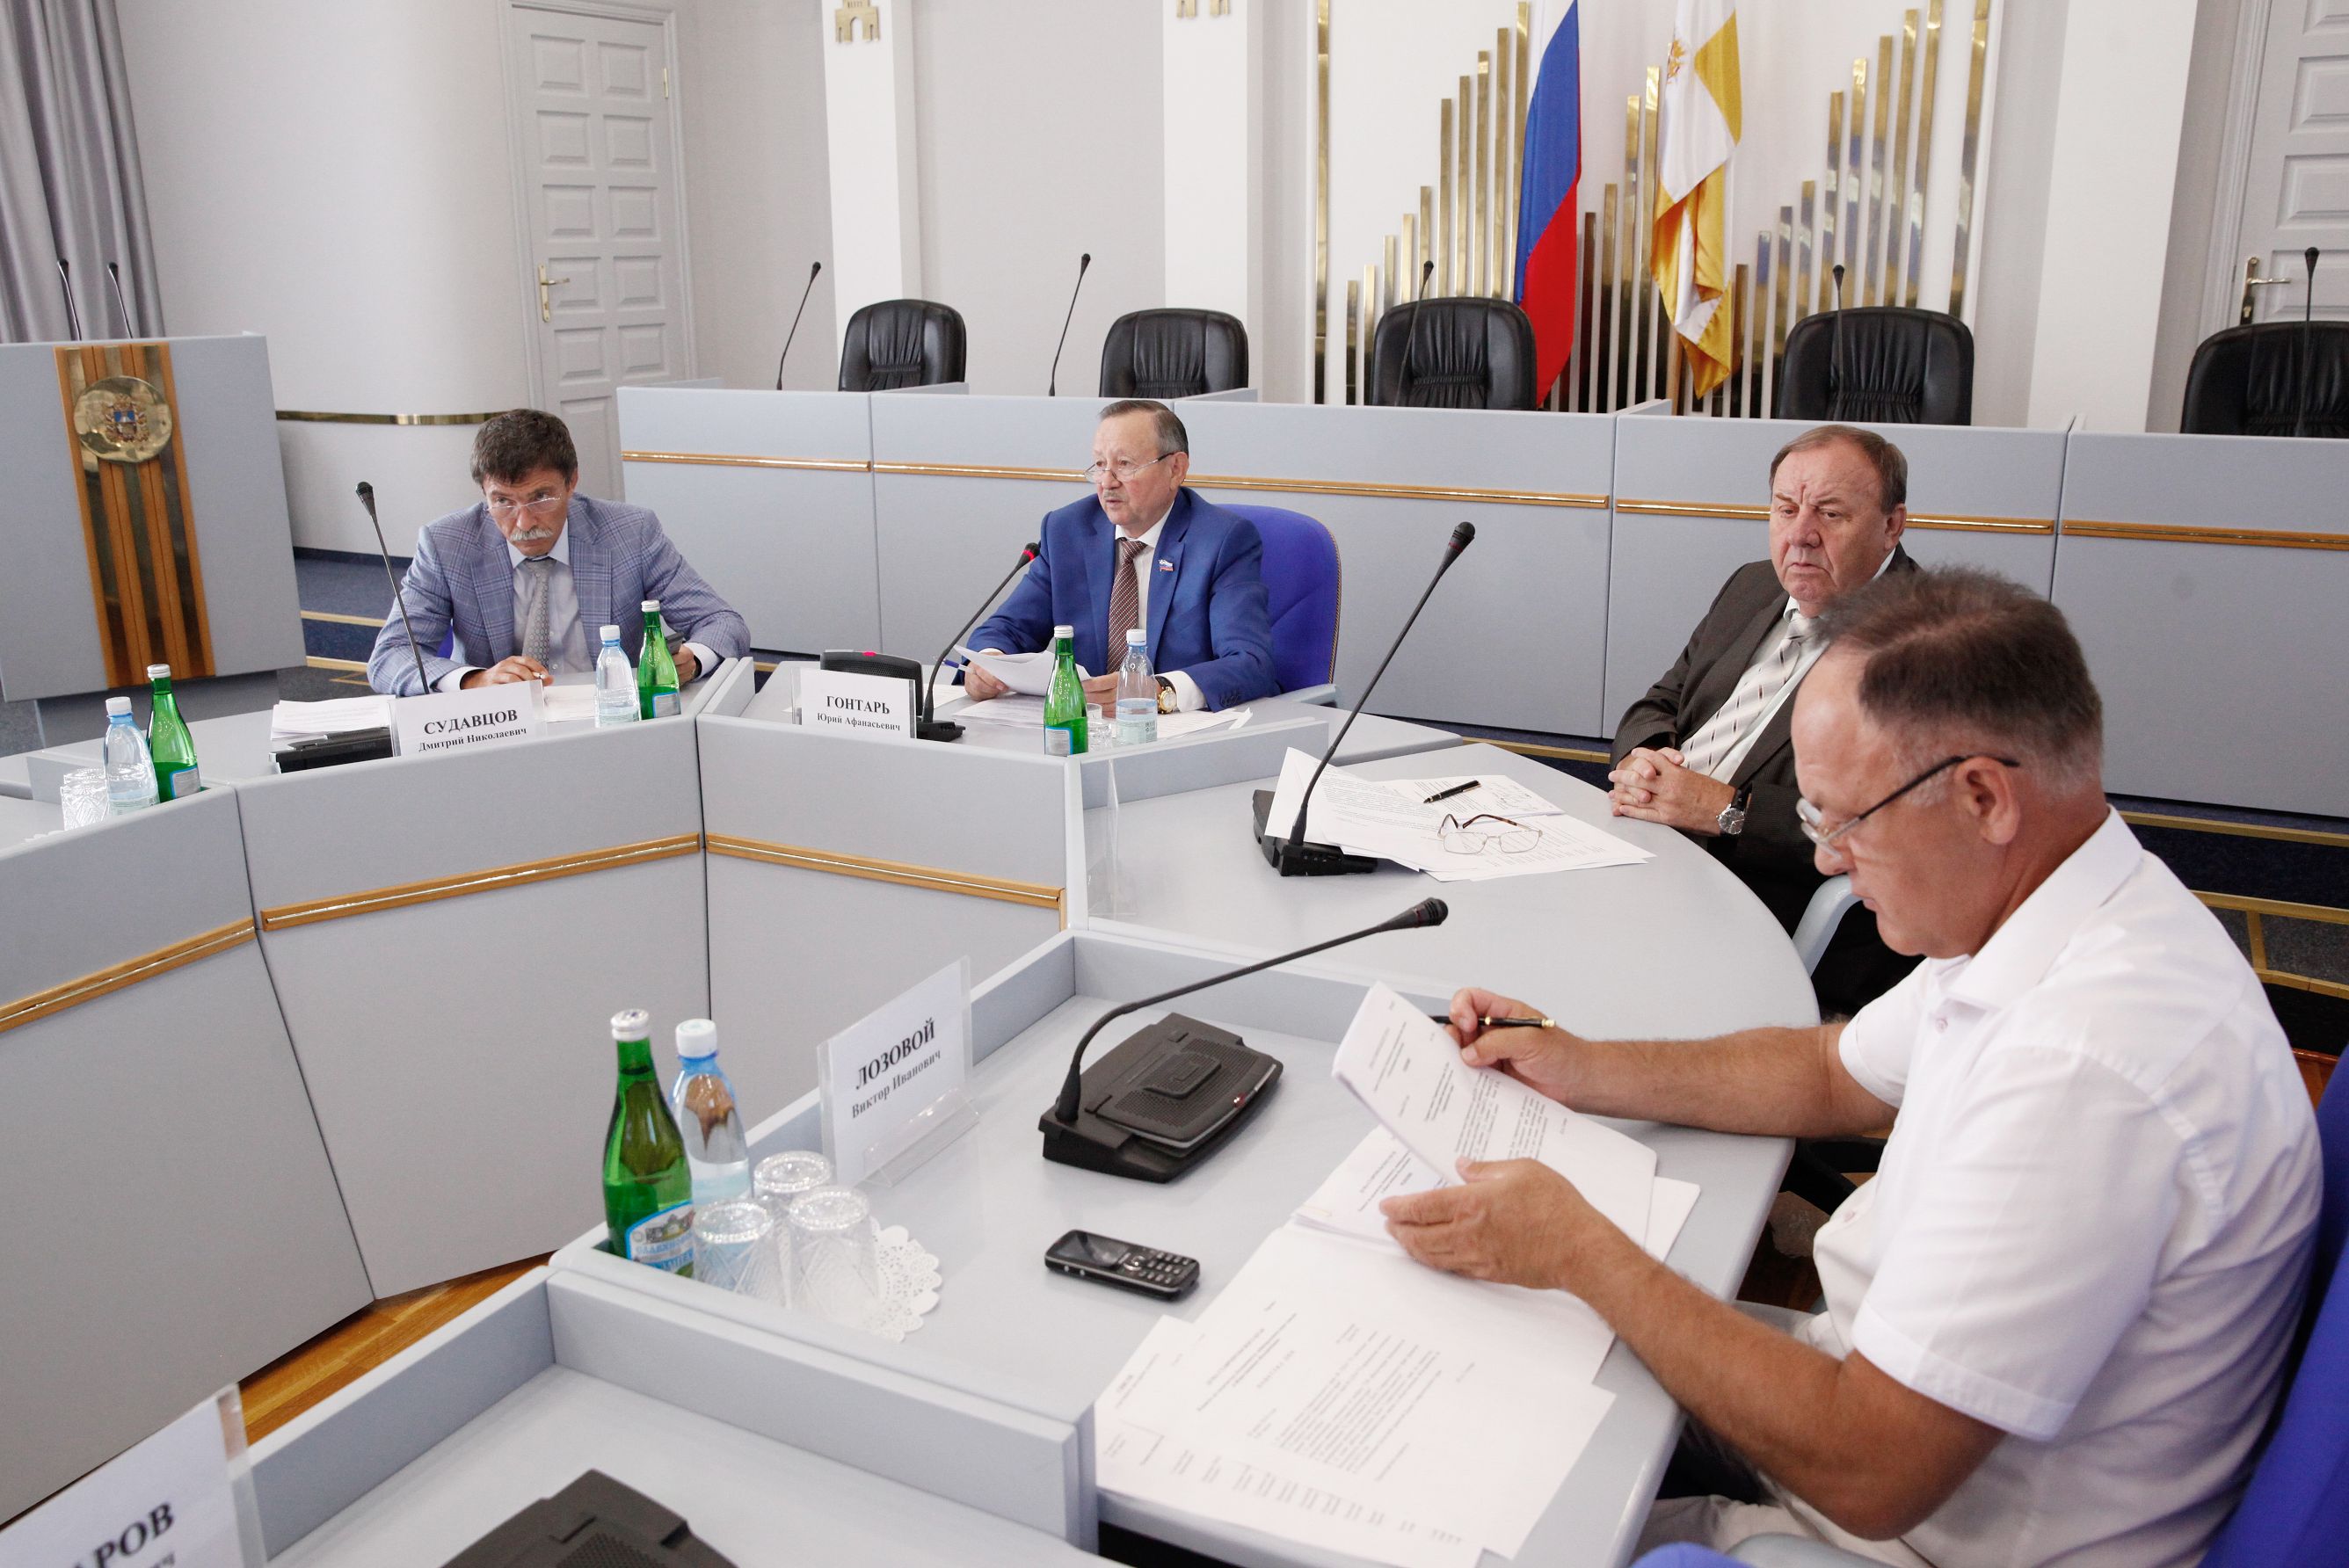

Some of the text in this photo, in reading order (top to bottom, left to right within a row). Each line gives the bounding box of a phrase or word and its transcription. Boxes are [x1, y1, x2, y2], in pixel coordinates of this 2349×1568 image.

[826, 695, 890, 715] ГОНТАРЬ
[424, 709, 518, 735] СУДАВЦОВ
[817, 712, 900, 731] Юрий Афанасьевич
[418, 728, 527, 752] Дмитрий Николаевич
[855, 1017, 935, 1090] ЛОЗОВОЙ
[852, 1050, 942, 1119] Виктор Иванович
[70, 1502, 175, 1568] РОВ
